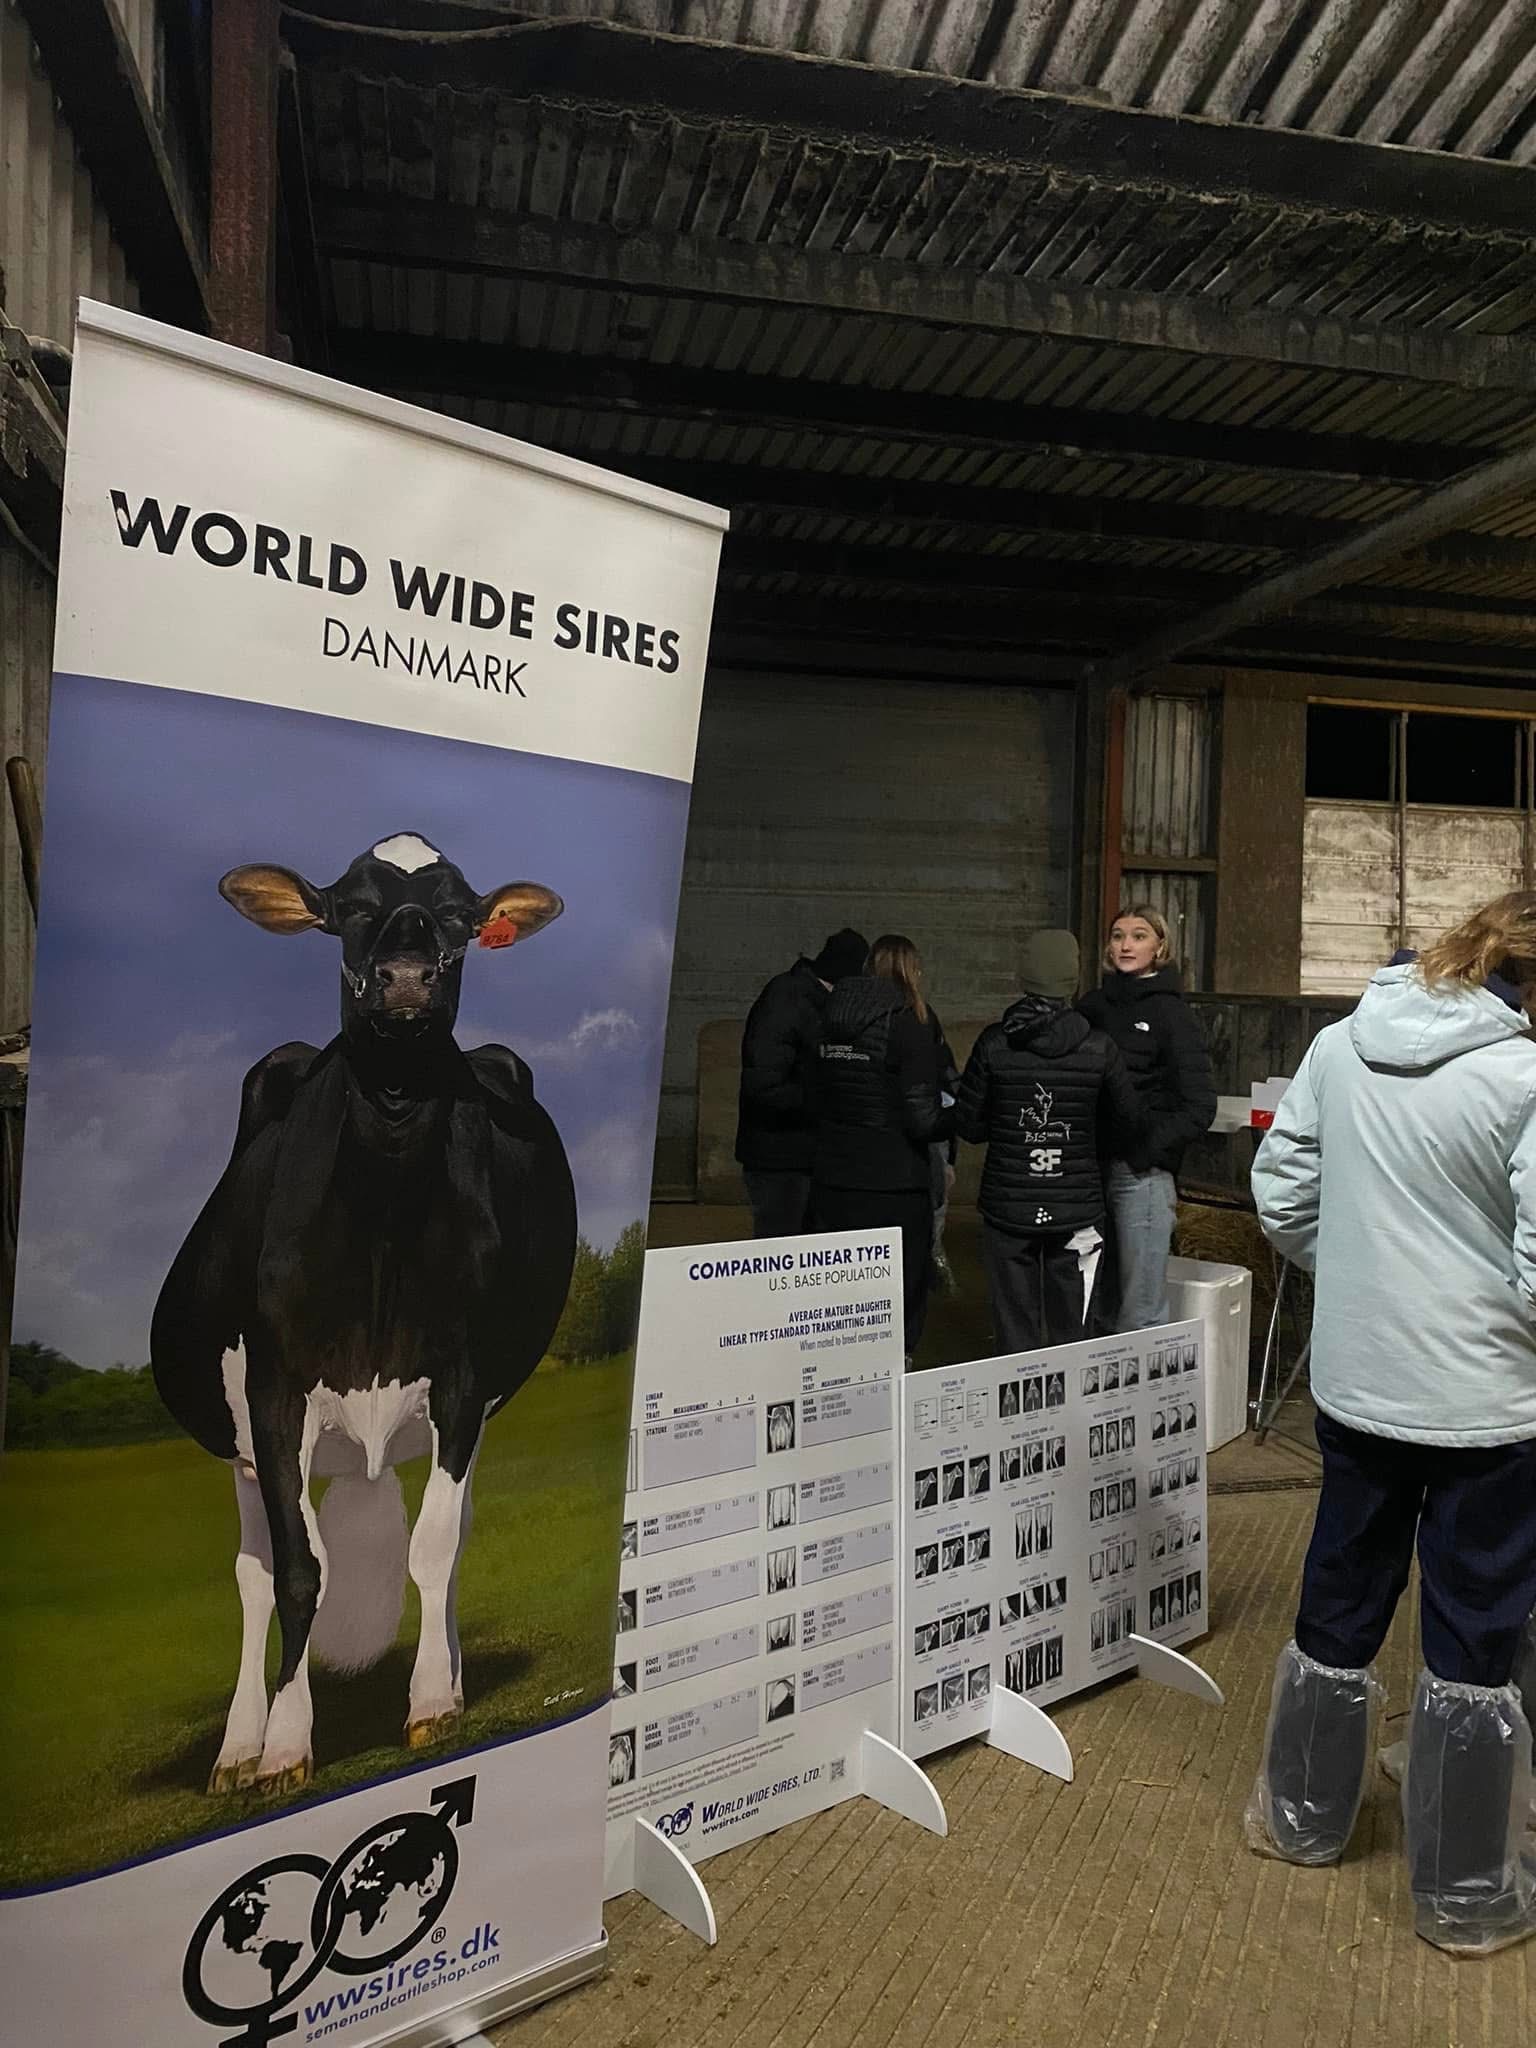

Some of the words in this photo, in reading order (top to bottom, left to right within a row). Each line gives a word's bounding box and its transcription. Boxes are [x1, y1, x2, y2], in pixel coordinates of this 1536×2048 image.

[110, 489, 367, 596] WORLD
[390, 560, 535, 639] WIDE
[553, 603, 680, 674] SIRES
[323, 617, 528, 697] DANMARK
[1030, 1149, 1062, 1171] 3F
[689, 1253, 794, 1281] COMPARING
[799, 1248, 852, 1268] LINEAR
[857, 1244, 890, 1262] TYPE
[769, 1277, 791, 1291] U.S.
[795, 1274, 822, 1288] BASE
[826, 1266, 890, 1284] POPULATION
[789, 1308, 823, 1323] AVERAGE
[825, 1303, 854, 1318] MATURE
[856, 1300, 891, 1314] DAUGHTER
[720, 1332, 747, 1347] LINEAR
[749, 1330, 768, 1342] TYPE
[770, 1323, 810, 1340] STANDARD
[812, 1316, 864, 1333] TRANSMITTING
[867, 1313, 892, 1326] ABILITY
[800, 1340, 814, 1351] When
[645, 1657, 658, 1666] FOOT
[645, 1722, 658, 1732] REAR
[702, 1798, 743, 1824] WORLD
[746, 1786, 770, 1806] WIDE
[773, 1777, 801, 1797] SIRES,
[803, 1768, 822, 1785] LTD.
[702, 1807, 759, 1835] wwsires.com
[305, 1921, 500, 2025] wwsires.dk
[305, 1951, 500, 2044] semenandcattleshop.com
